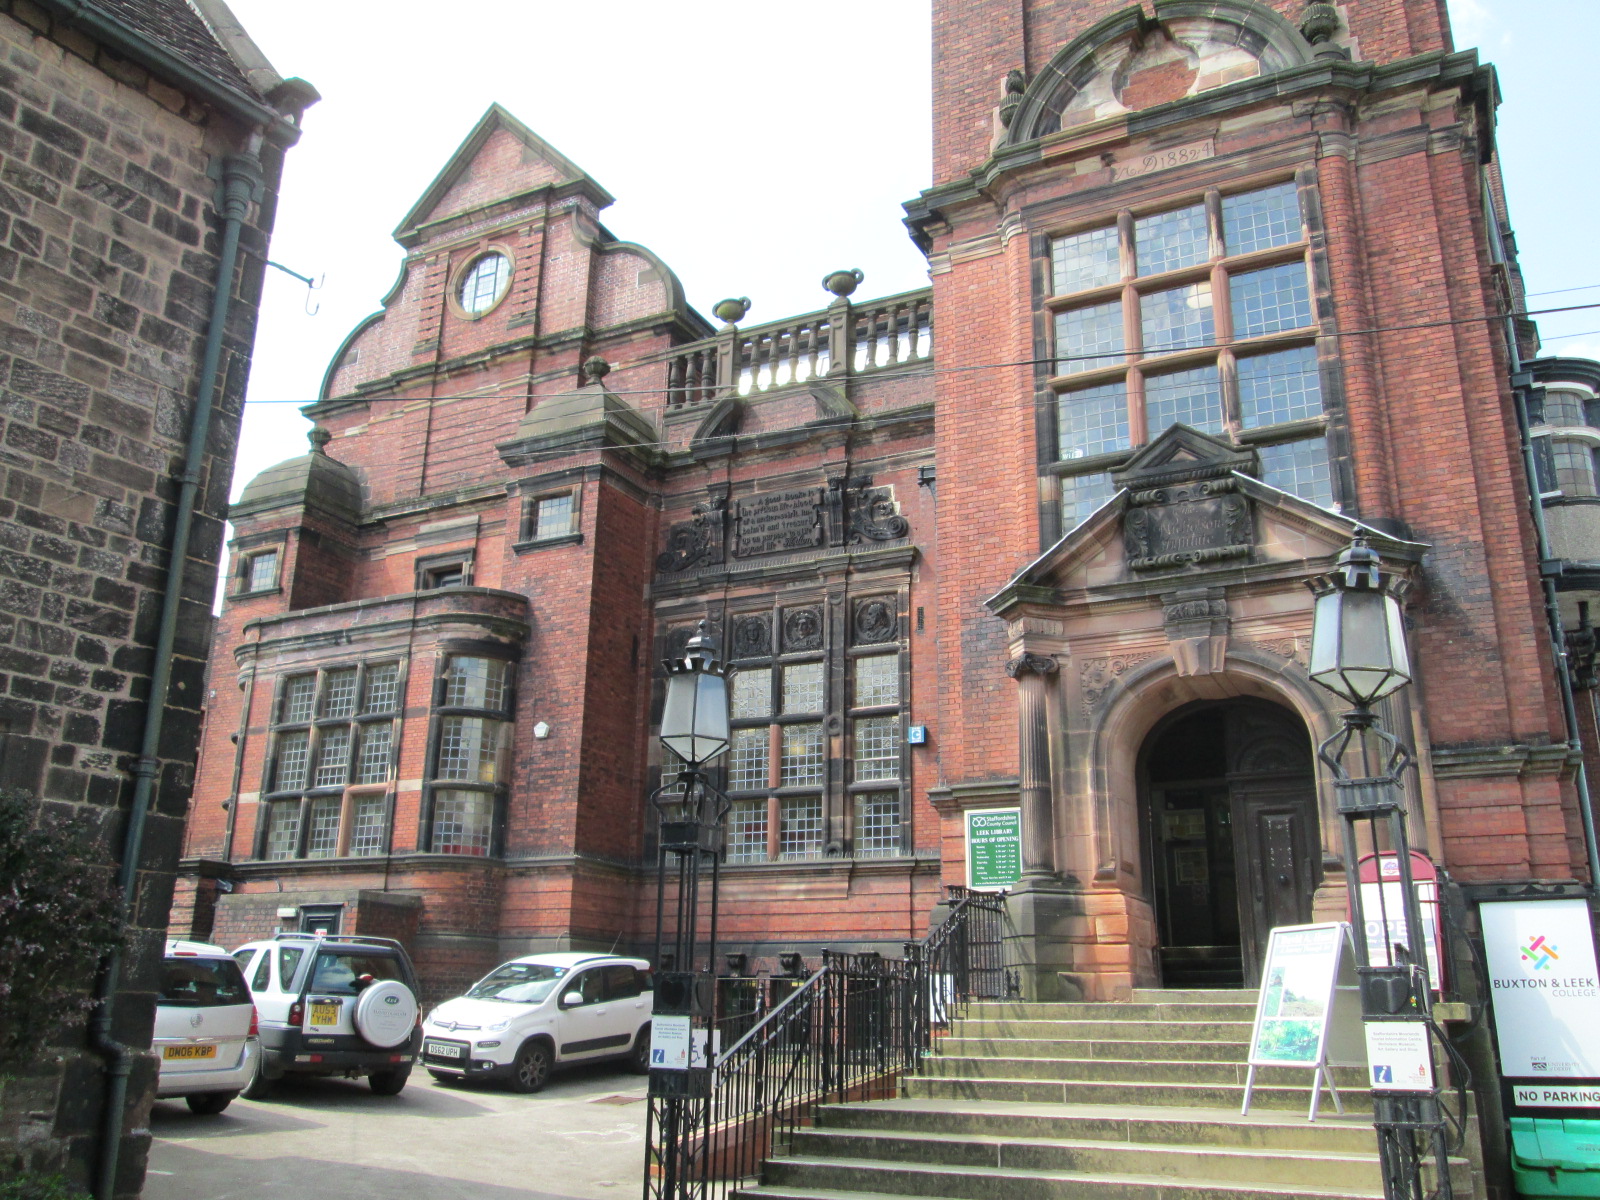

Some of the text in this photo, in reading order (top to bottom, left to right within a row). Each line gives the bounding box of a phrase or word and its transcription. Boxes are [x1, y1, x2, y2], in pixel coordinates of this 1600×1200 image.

[767, 522, 780, 531] and
[1365, 920, 1409, 937] OPE
[1493, 978, 1594, 989] BUXTON & LEEK
[1552, 989, 1597, 998] COLLEGE
[430, 1045, 458, 1057] DS62 UPH
[1518, 1091, 1600, 1103] NO PARKING
